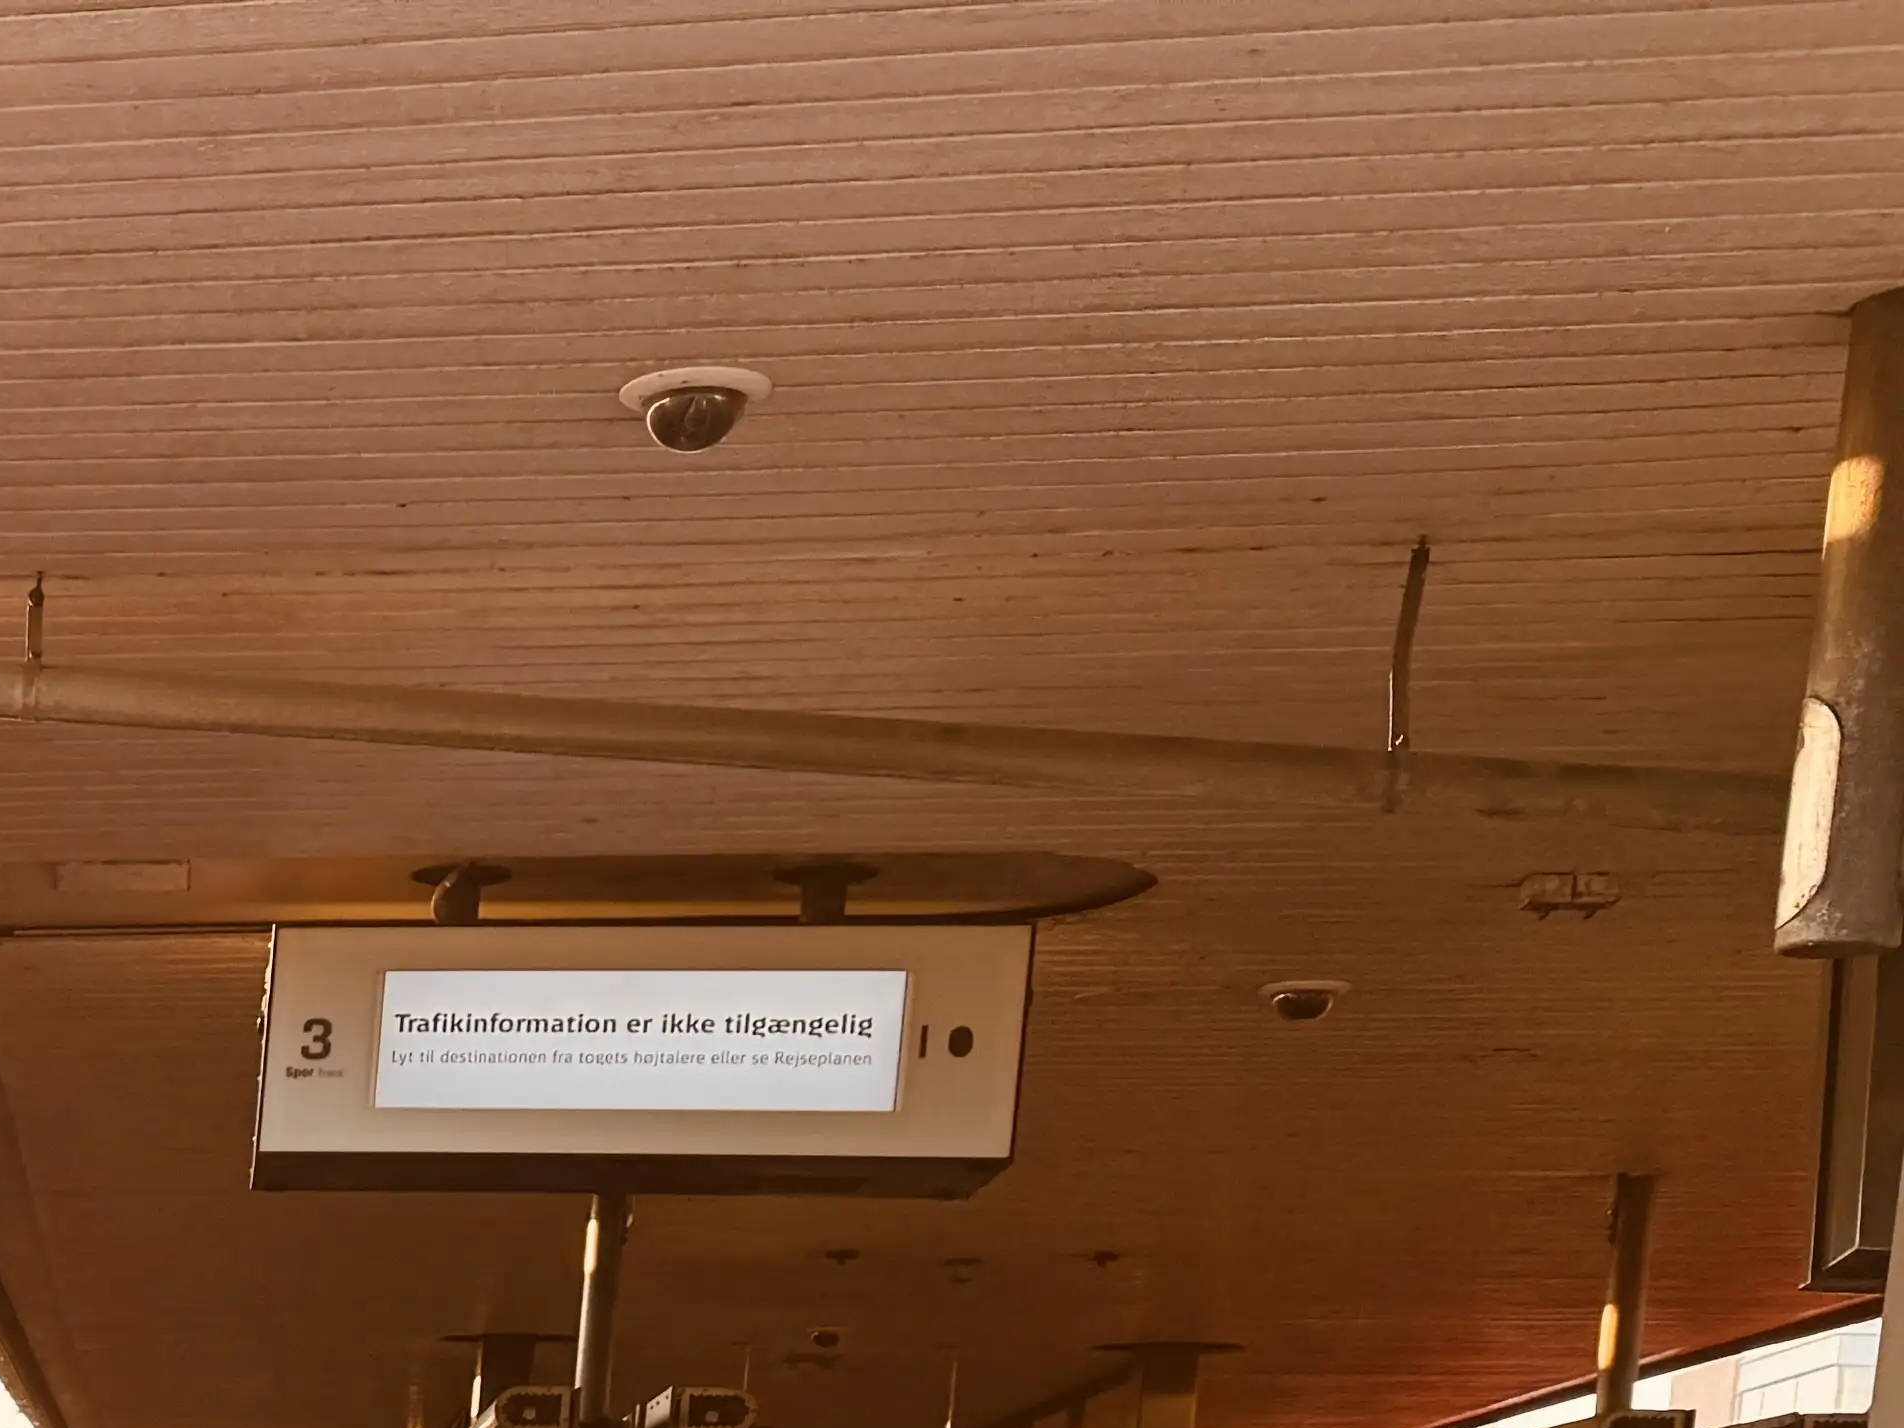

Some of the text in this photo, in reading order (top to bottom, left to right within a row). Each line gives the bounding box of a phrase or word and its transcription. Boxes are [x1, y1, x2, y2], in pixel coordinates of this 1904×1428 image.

[395, 1013, 873, 1038] Trafikinformation er ikke tilgængelig
[300, 1017, 333, 1060] 3
[391, 1050, 413, 1066] Lyt
[419, 1050, 434, 1064] til
[440, 1050, 547, 1064] destinationen
[552, 1050, 572, 1064] fra
[579, 1051, 628, 1066] togets
[711, 1050, 746, 1065] eller
[752, 1053, 769, 1065] se
[774, 1051, 872, 1068] Rejseplanen
